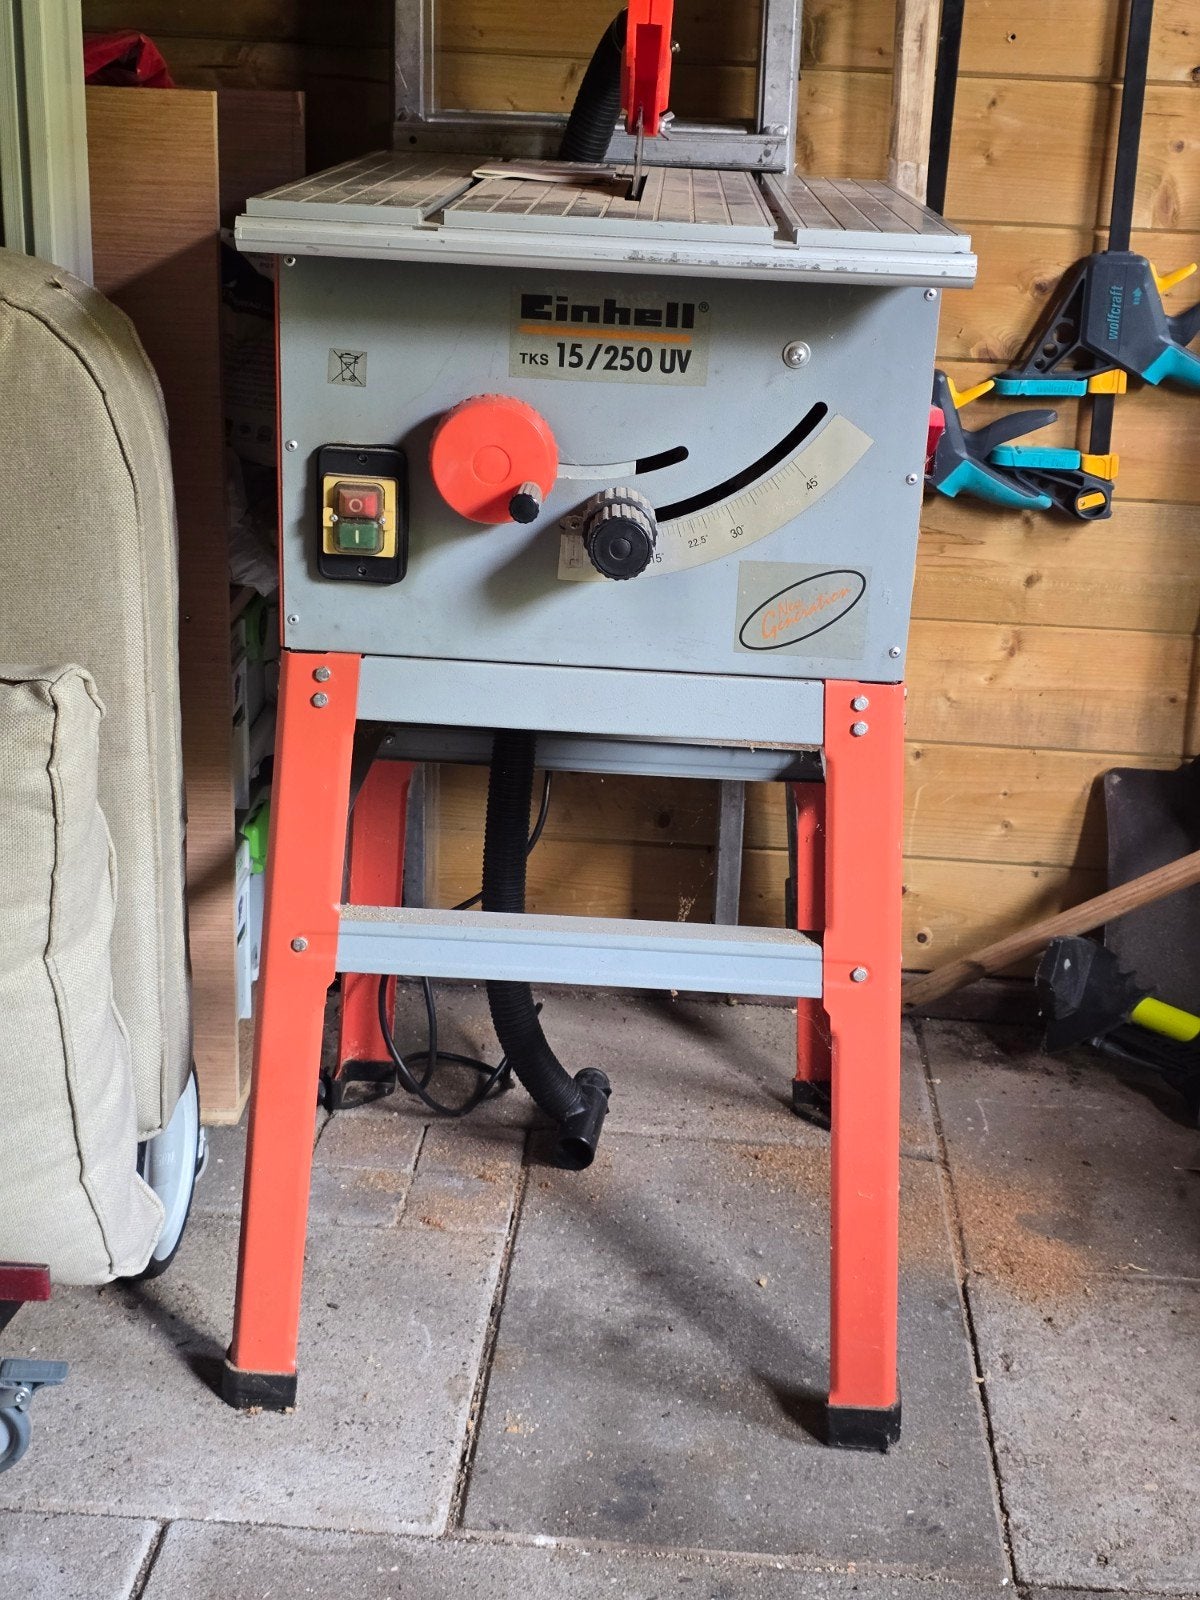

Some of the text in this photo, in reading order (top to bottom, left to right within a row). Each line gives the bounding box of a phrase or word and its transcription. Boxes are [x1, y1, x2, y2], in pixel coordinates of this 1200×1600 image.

[1107, 285, 1123, 340] wolfcraft
[519, 342, 692, 374] TKS 15/250 UV
